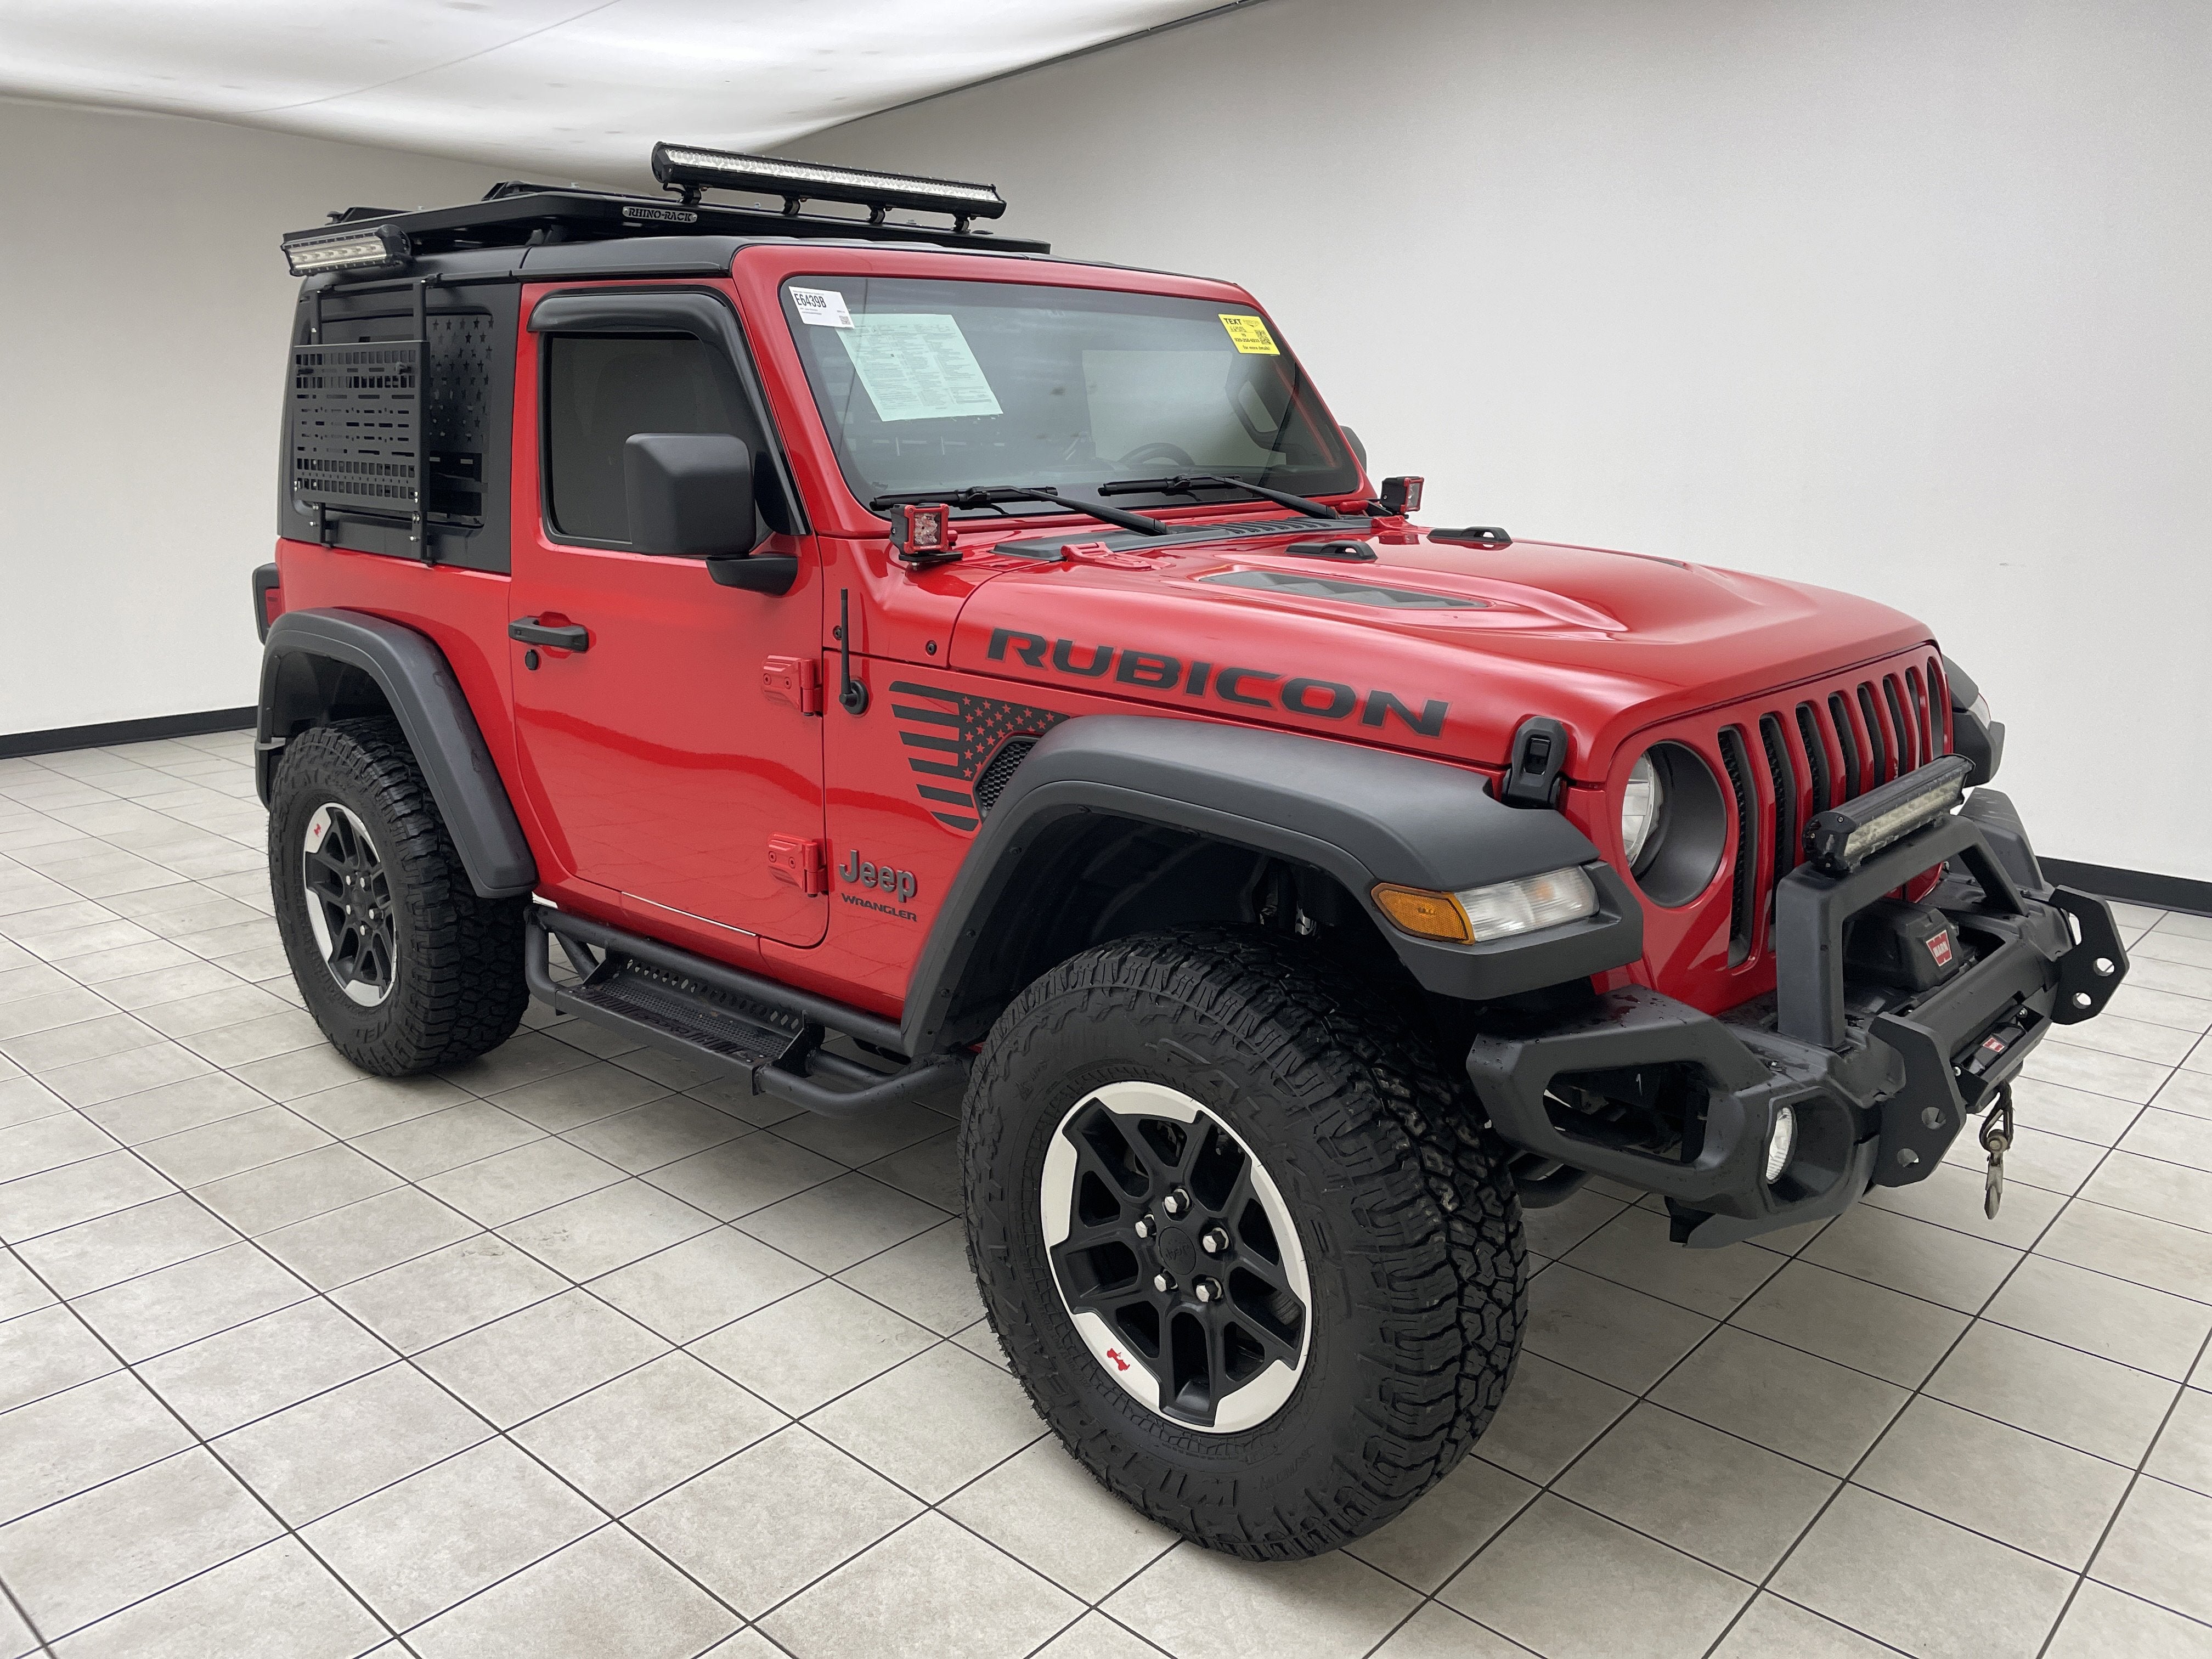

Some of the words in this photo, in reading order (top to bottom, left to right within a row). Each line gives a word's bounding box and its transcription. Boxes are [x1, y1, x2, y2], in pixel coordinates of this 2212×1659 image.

[628, 208, 692, 222] RHINO-RACK
[794, 293, 826, 308] E6439B
[987, 627, 1452, 739] RUBICON
[839, 849, 918, 903] Jeep
[841, 893, 917, 922] WRANGLER
[1932, 941, 1949, 958] WARN
